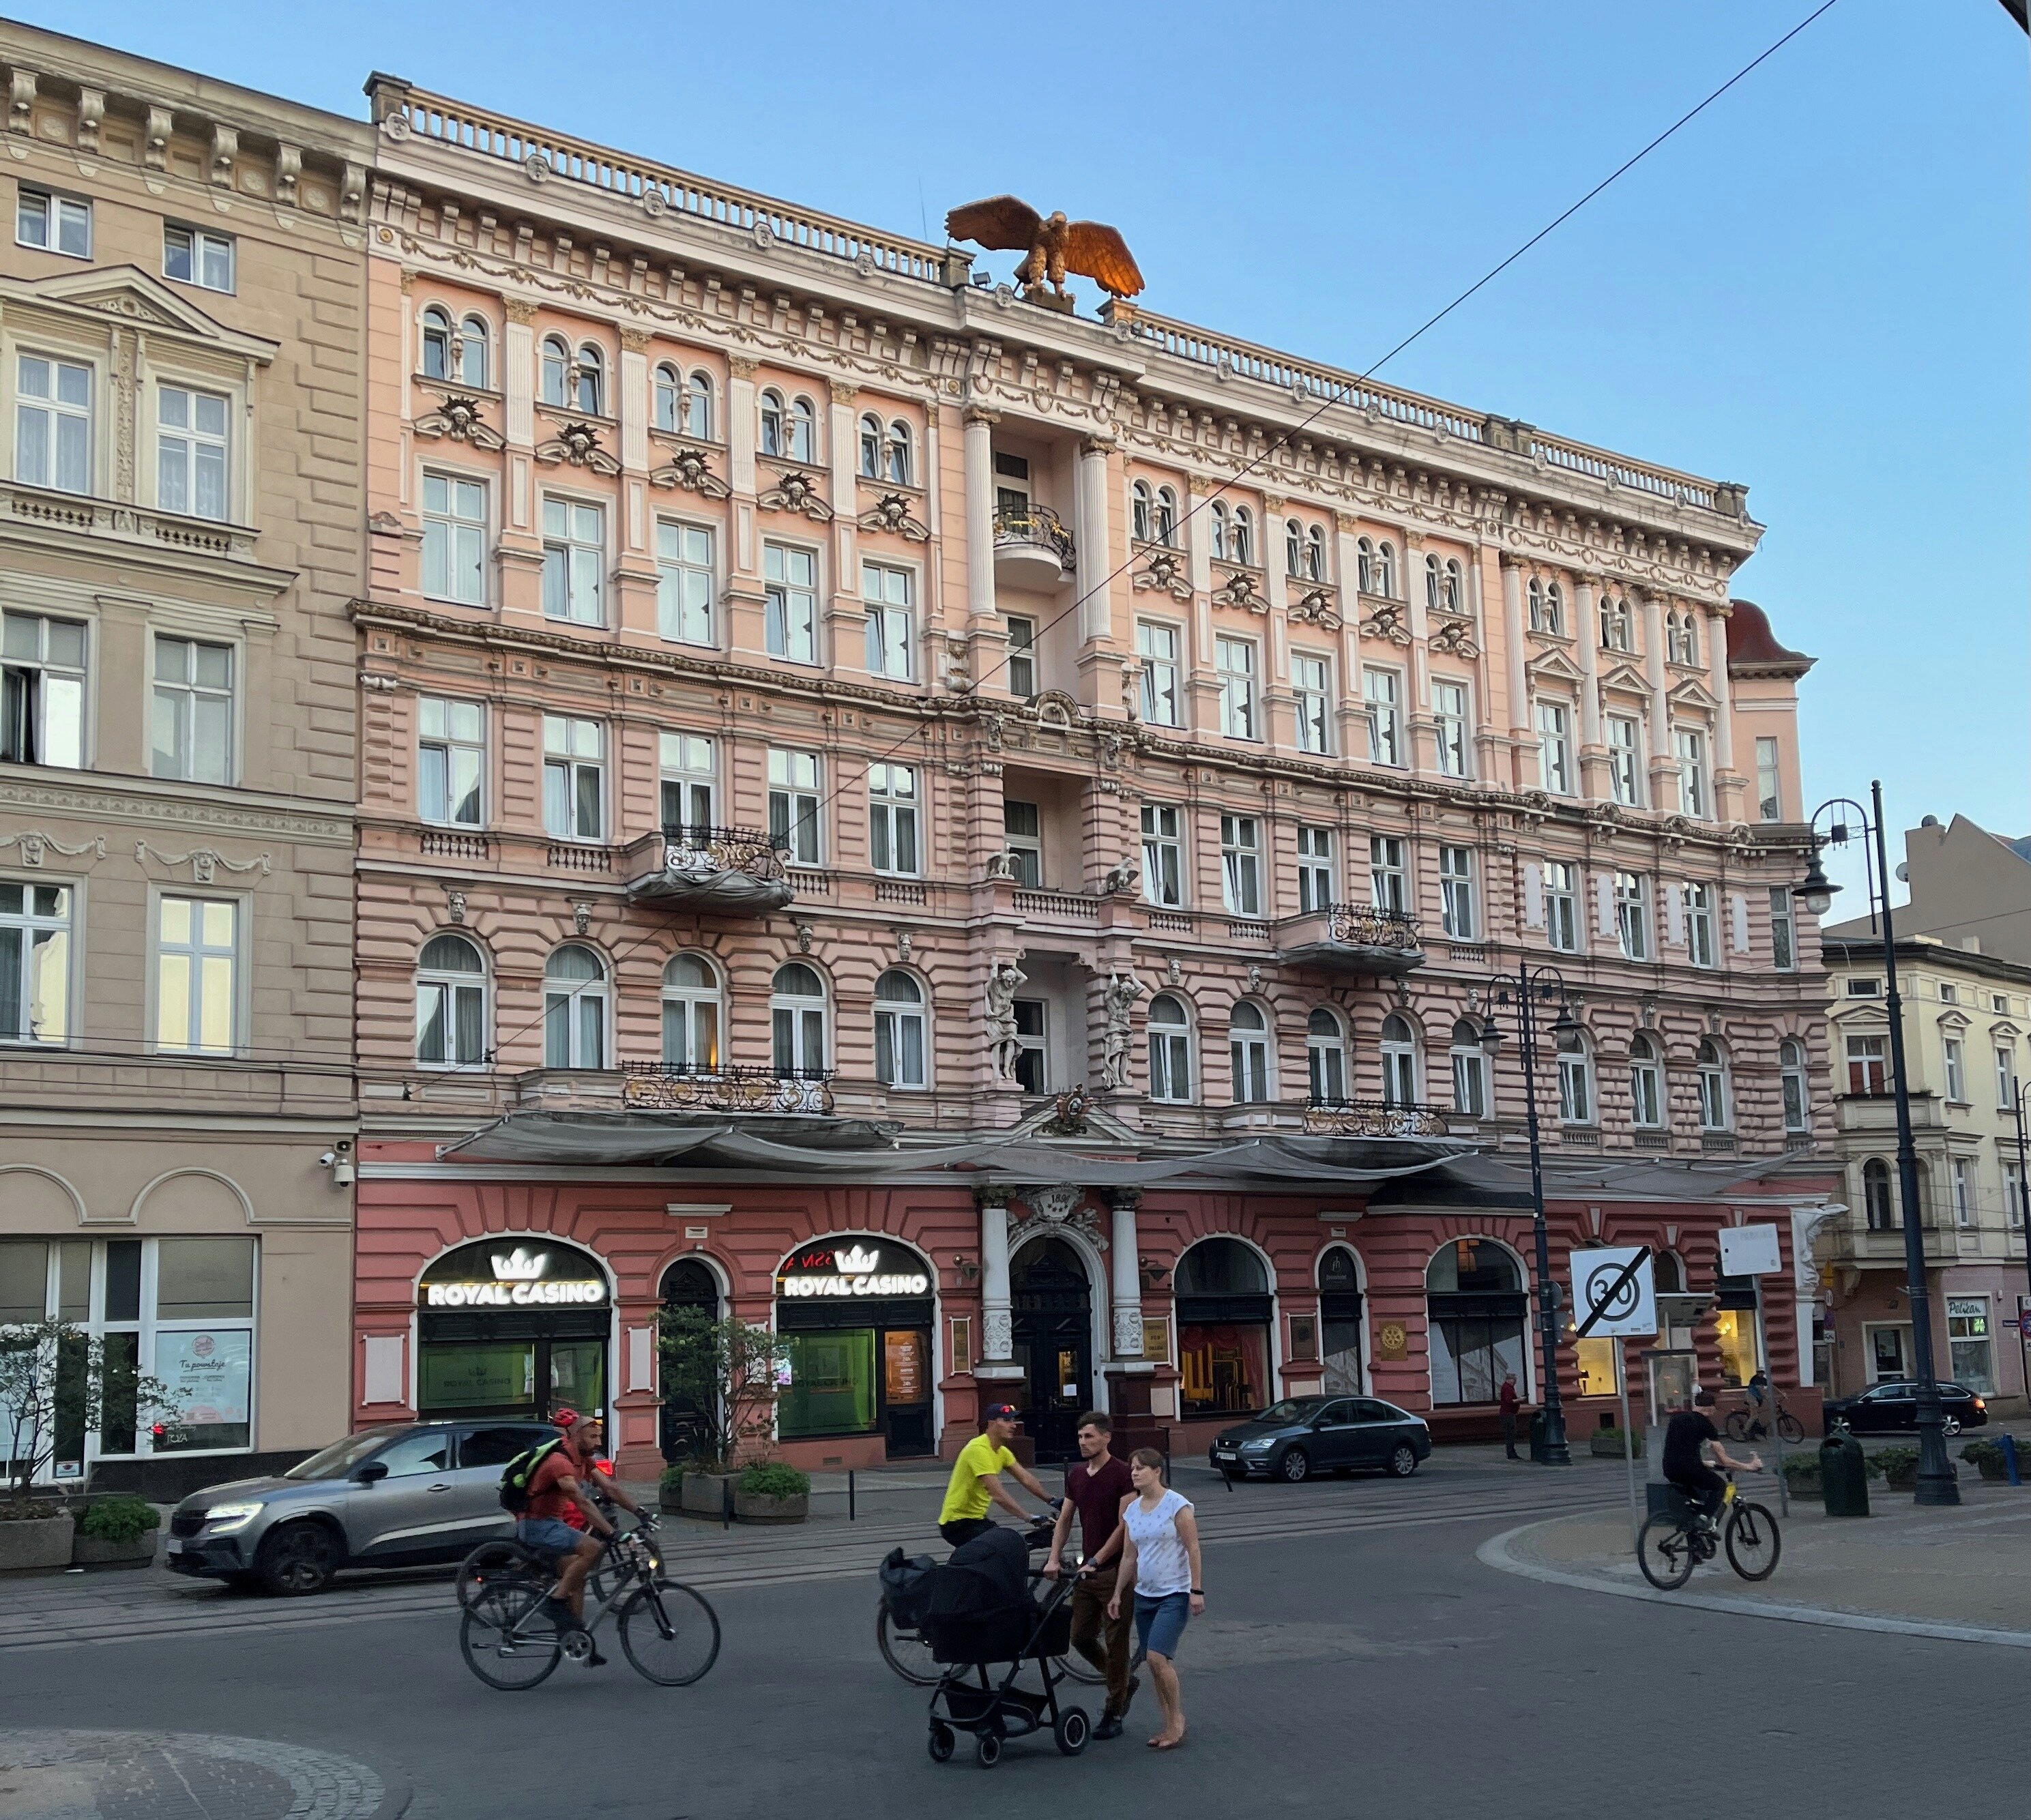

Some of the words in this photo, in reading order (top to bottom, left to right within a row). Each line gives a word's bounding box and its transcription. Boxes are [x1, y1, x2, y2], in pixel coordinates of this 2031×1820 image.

[428, 1285, 510, 1306] ROYAL
[511, 1283, 604, 1304] CASINO
[784, 1277, 852, 1297] ROYAL
[853, 1274, 928, 1295] CASINO
[1948, 1302, 1981, 1314] Pelikan
[179, 1360, 190, 1368] Tu
[190, 1358, 227, 1372] powstaje
